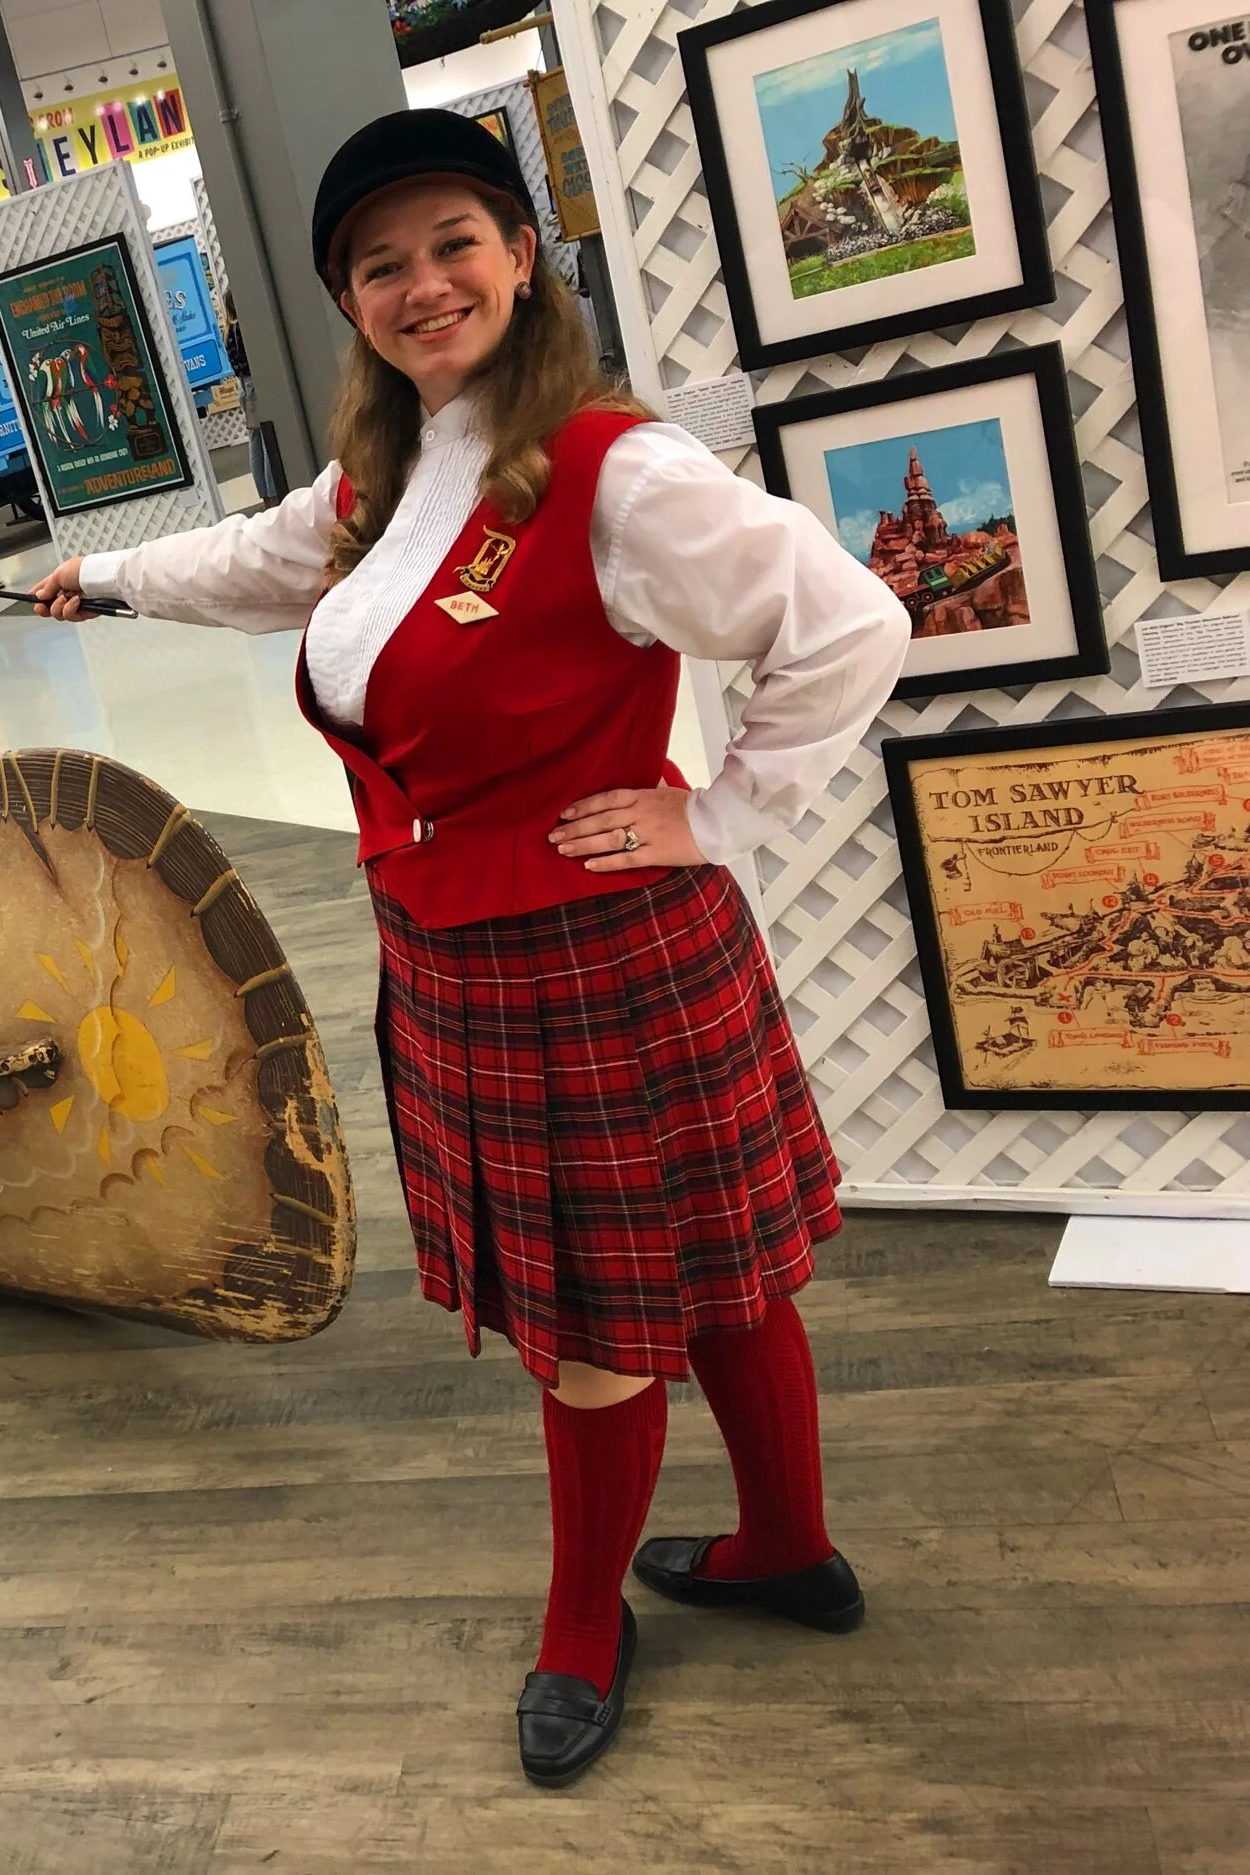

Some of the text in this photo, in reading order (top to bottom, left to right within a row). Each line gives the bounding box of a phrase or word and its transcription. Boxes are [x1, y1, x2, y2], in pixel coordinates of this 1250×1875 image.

[1188, 21, 1246, 51] ONE
[22, 323, 50, 340] United
[49, 320, 66, 333] Air
[65, 313, 90, 327] Lines
[84, 458, 176, 495] ADVENTURELAND
[450, 600, 480, 613] BETH
[929, 774, 1145, 810] TOM SAWYER
[968, 807, 1085, 833] ISLAND
[978, 841, 1059, 858] FRONTIERLAND
[985, 907, 1007, 915] MILL
